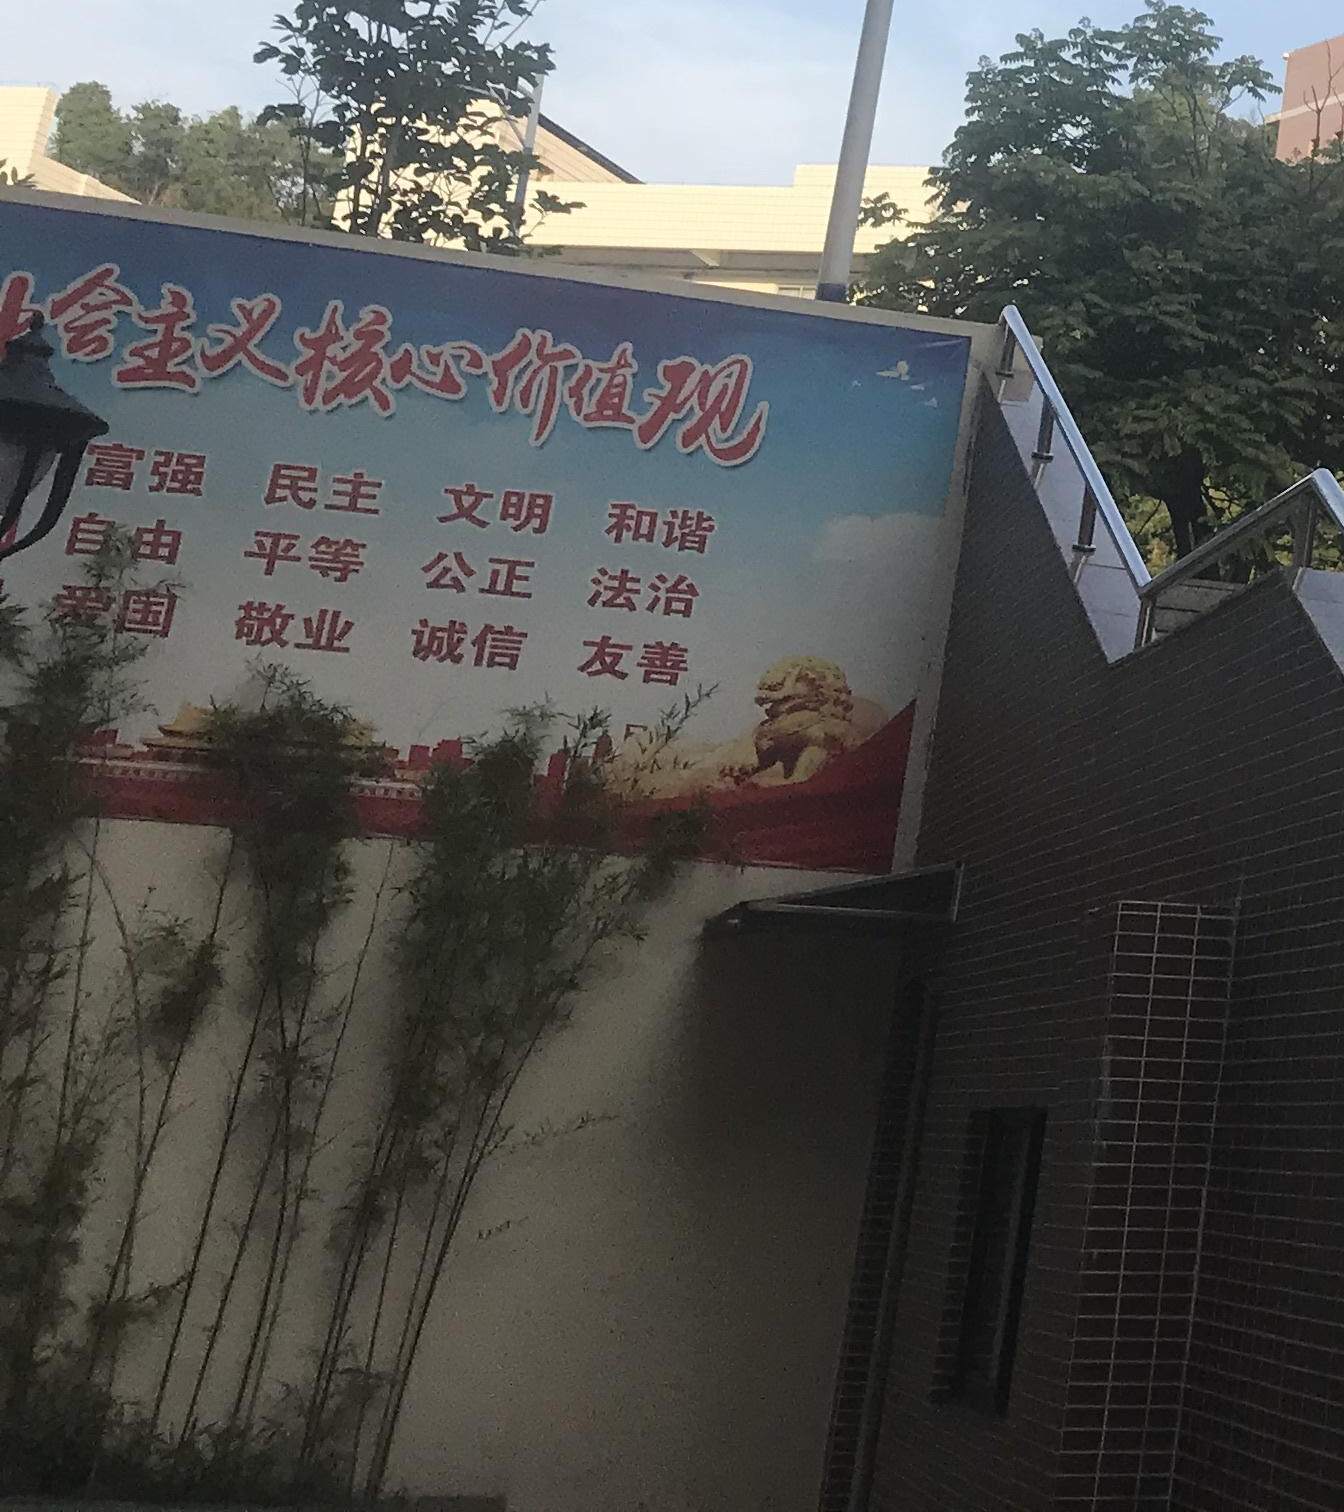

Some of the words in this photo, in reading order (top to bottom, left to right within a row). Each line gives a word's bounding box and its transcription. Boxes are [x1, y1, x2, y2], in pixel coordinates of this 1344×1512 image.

[86, 443, 206, 496] 富强
[264, 463, 383, 515] 民主
[437, 484, 554, 534] 文明
[605, 502, 715, 554] 和谐
[65, 512, 182, 565] 自由
[244, 530, 367, 583] 平等
[421, 552, 535, 599] 公正
[587, 568, 700, 618] 法治
[235, 601, 354, 653] 敬业
[411, 619, 528, 670] 诚信
[577, 635, 689, 686] 友善
